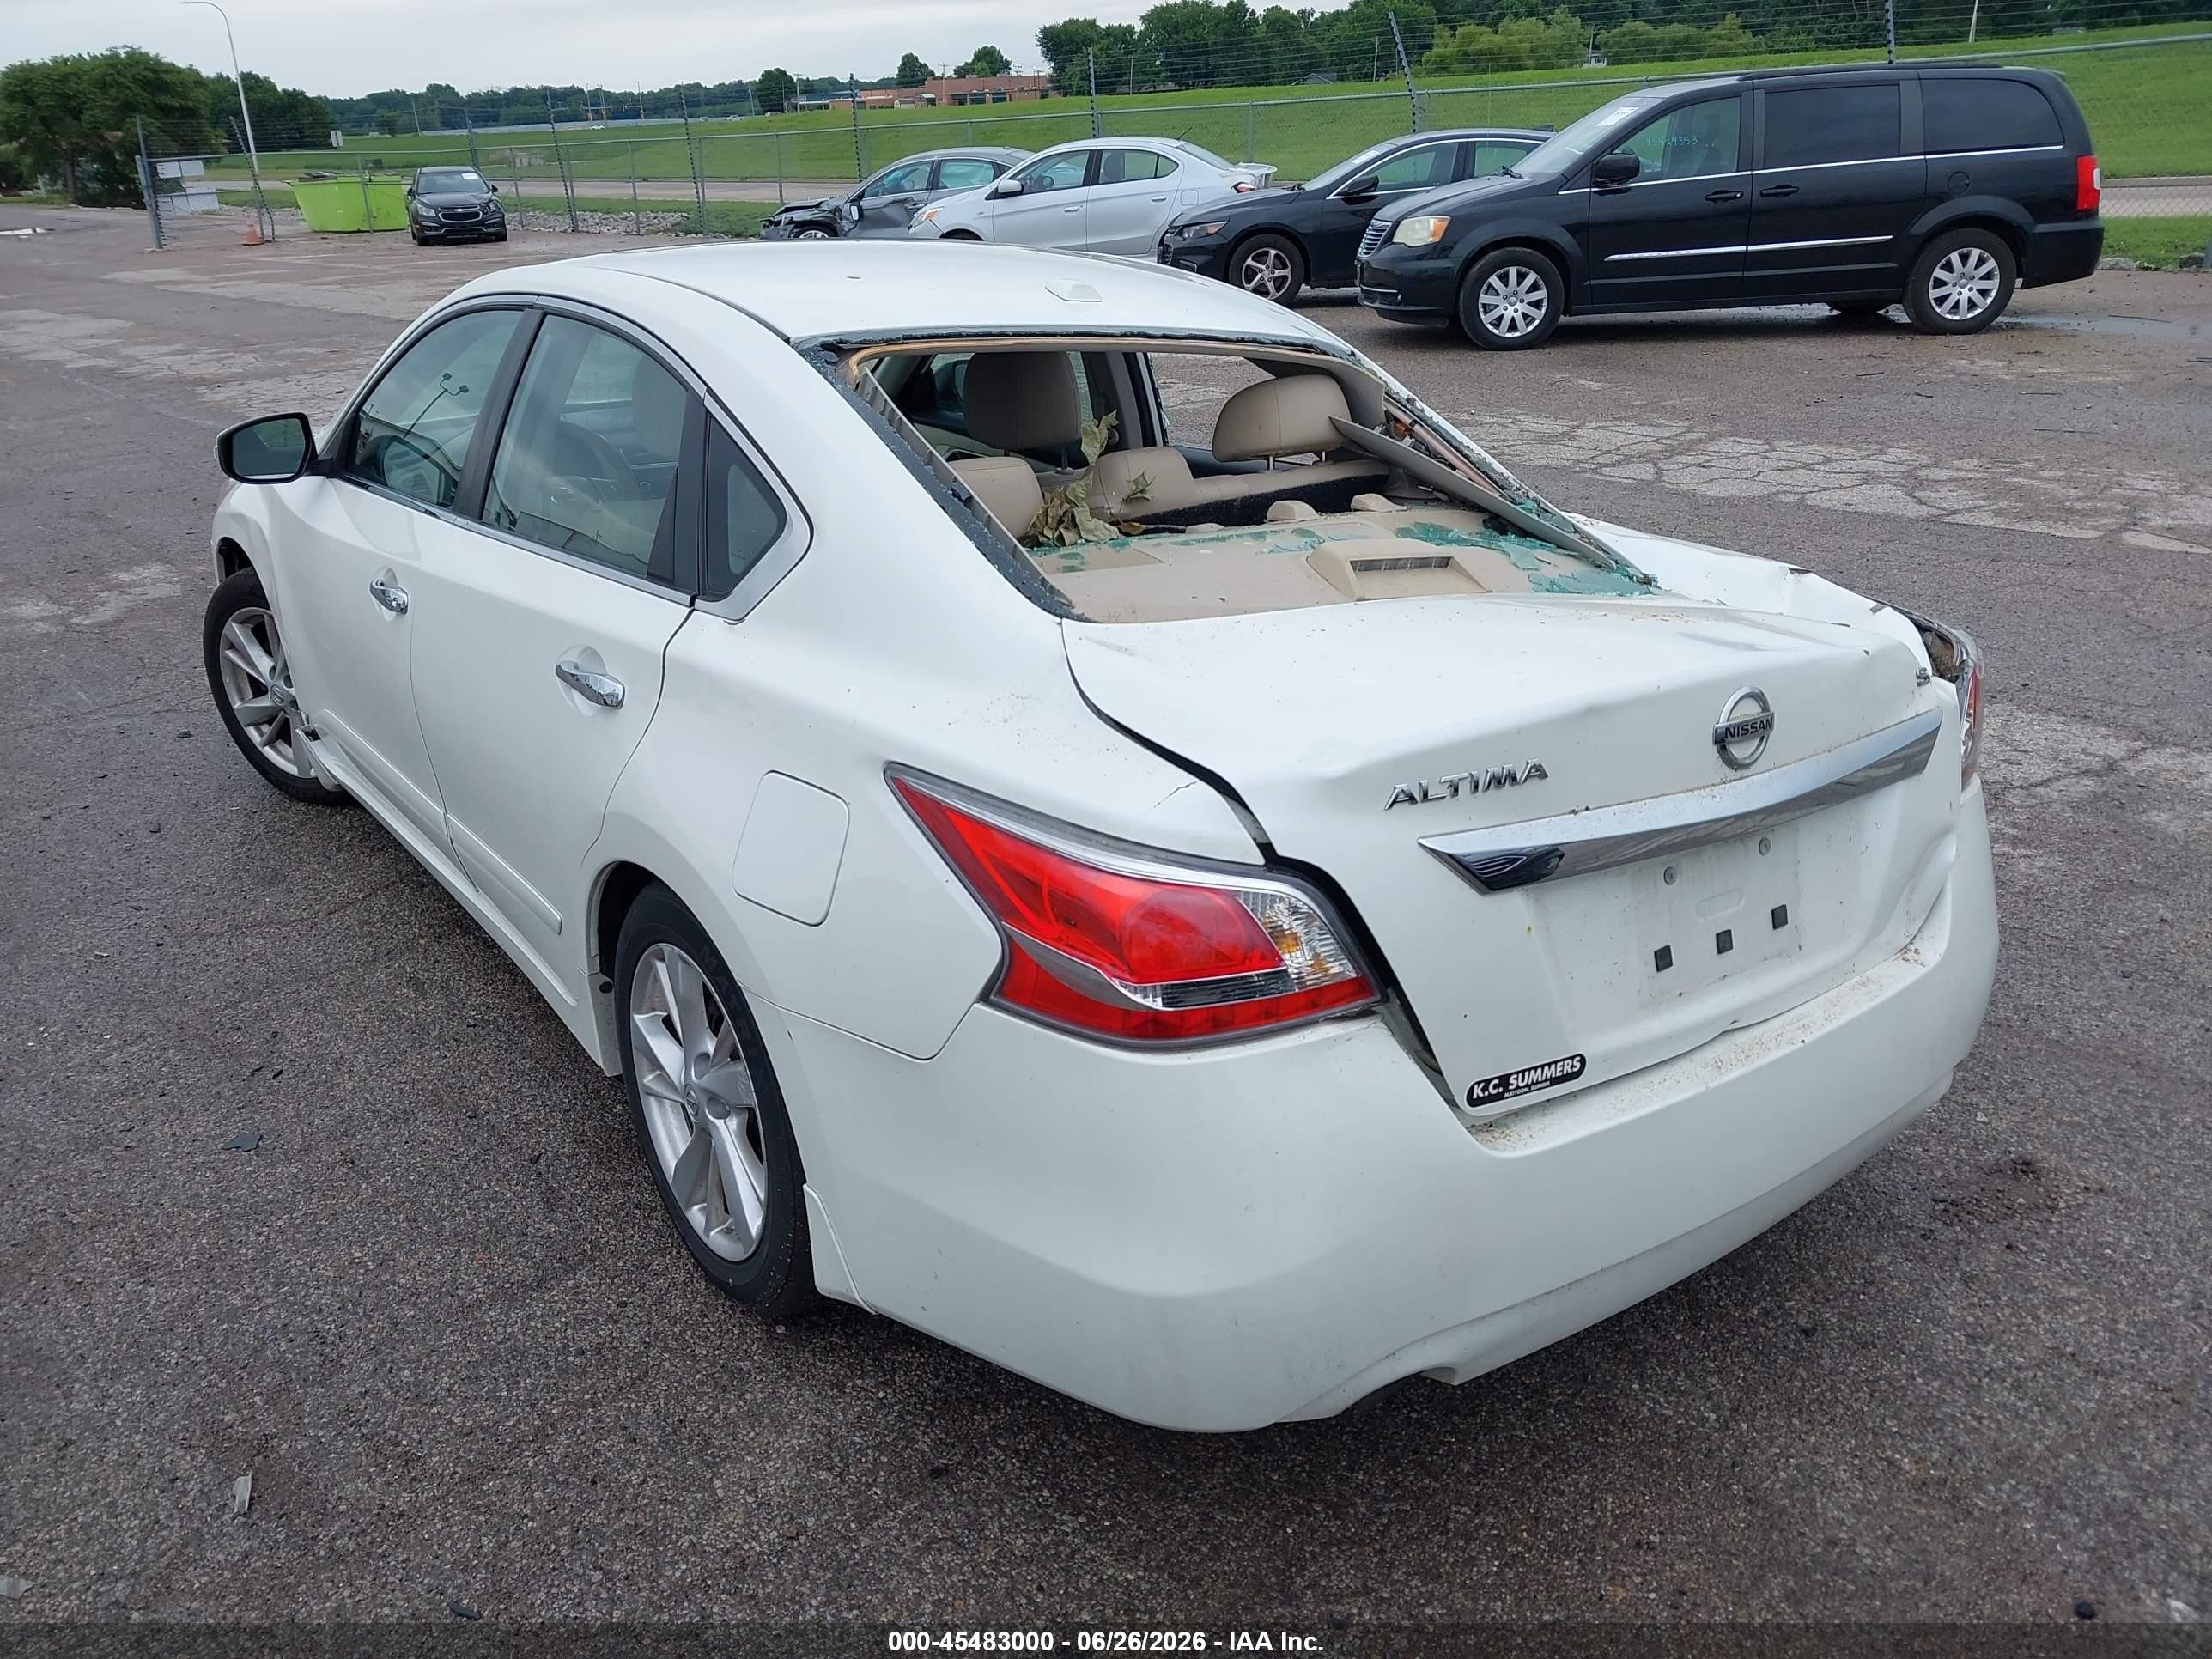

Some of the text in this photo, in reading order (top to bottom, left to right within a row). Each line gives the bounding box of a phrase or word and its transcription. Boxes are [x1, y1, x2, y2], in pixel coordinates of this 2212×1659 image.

[1724, 716, 1773, 738] NISSAN
[1383, 758, 1549, 811] ALTIMA
[1472, 1056, 1582, 1099] K.C. SUMMERS
